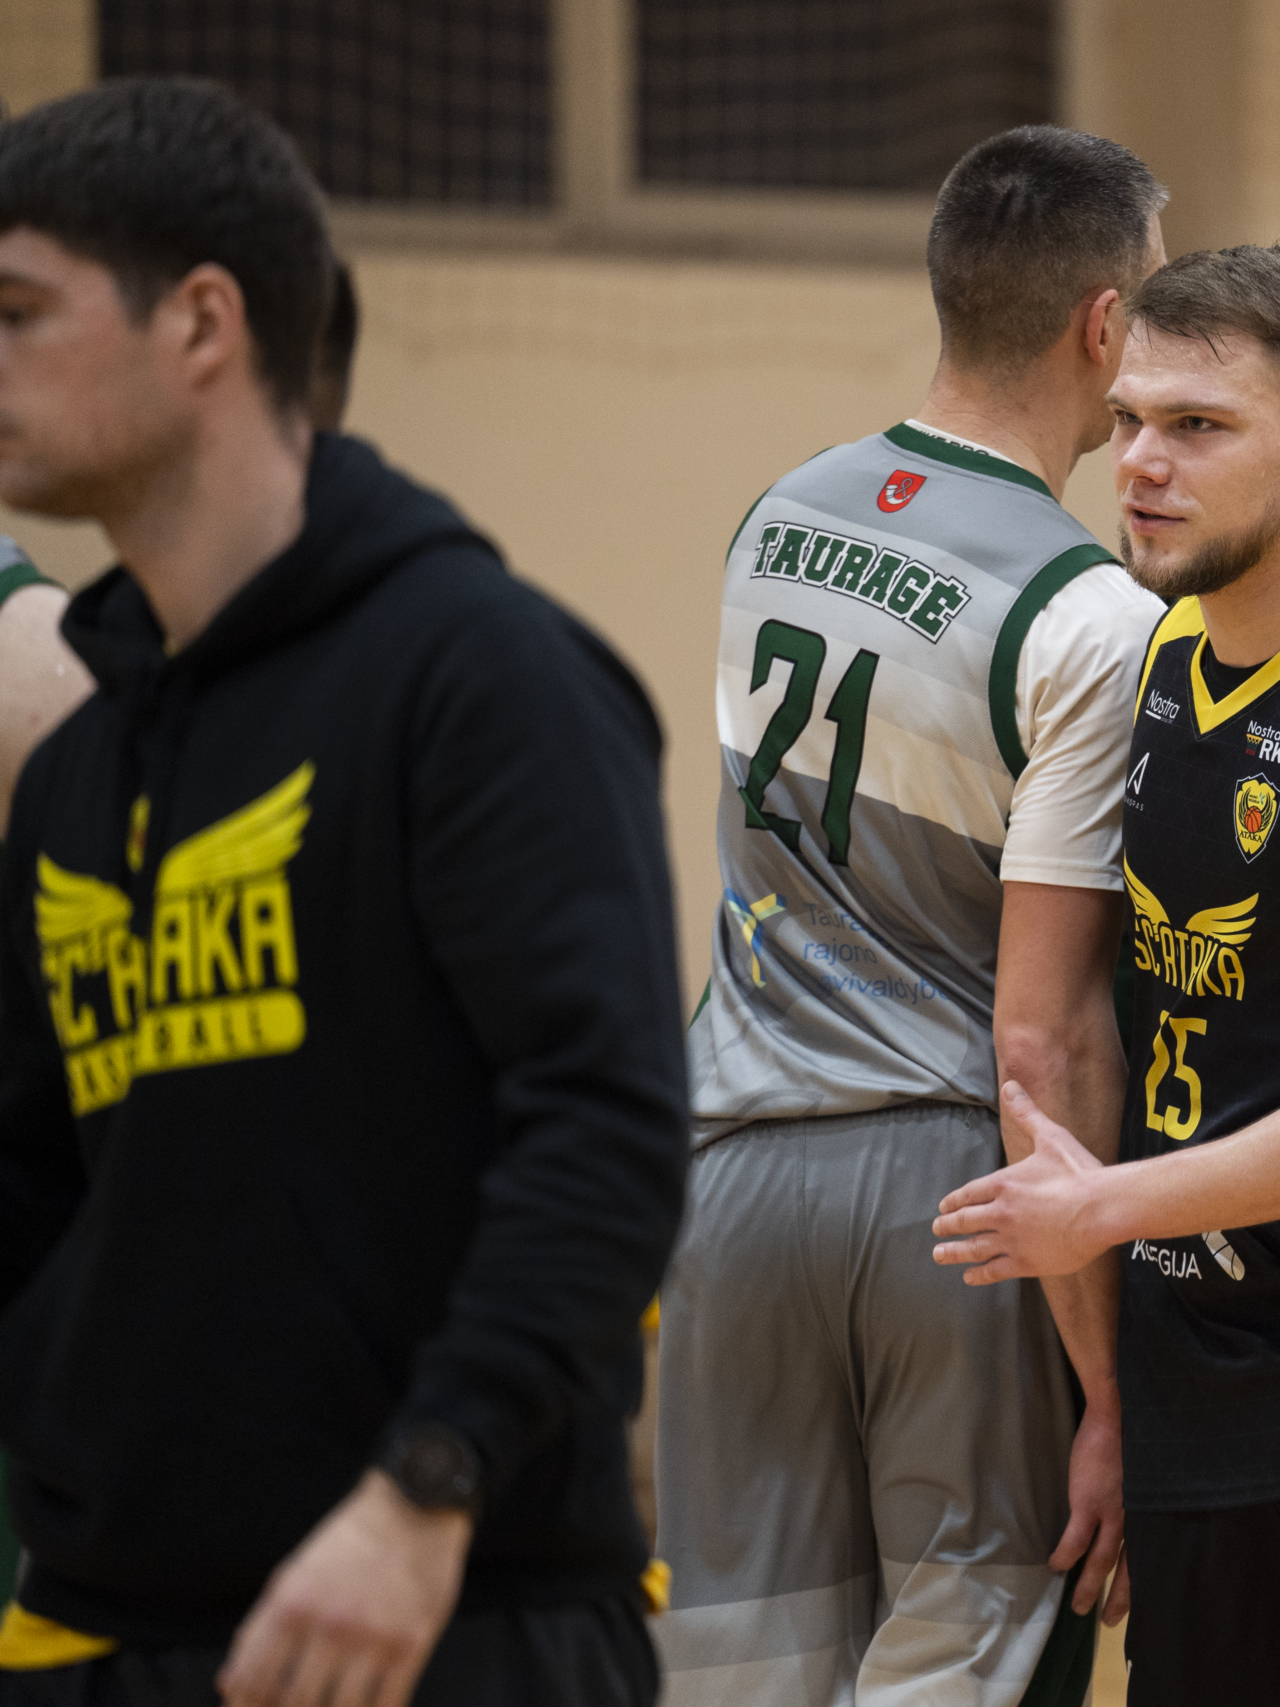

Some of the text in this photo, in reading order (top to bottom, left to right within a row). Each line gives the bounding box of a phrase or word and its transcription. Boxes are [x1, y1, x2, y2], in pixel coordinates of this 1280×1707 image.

[750, 521, 973, 645] TAURAGĖ
[740, 618, 881, 867] 21
[1147, 689, 1181, 720] Nostra
[1239, 829, 1263, 844] ATAKA
[804, 937, 878, 966] rajono
[1145, 1009, 1208, 1141] 25
